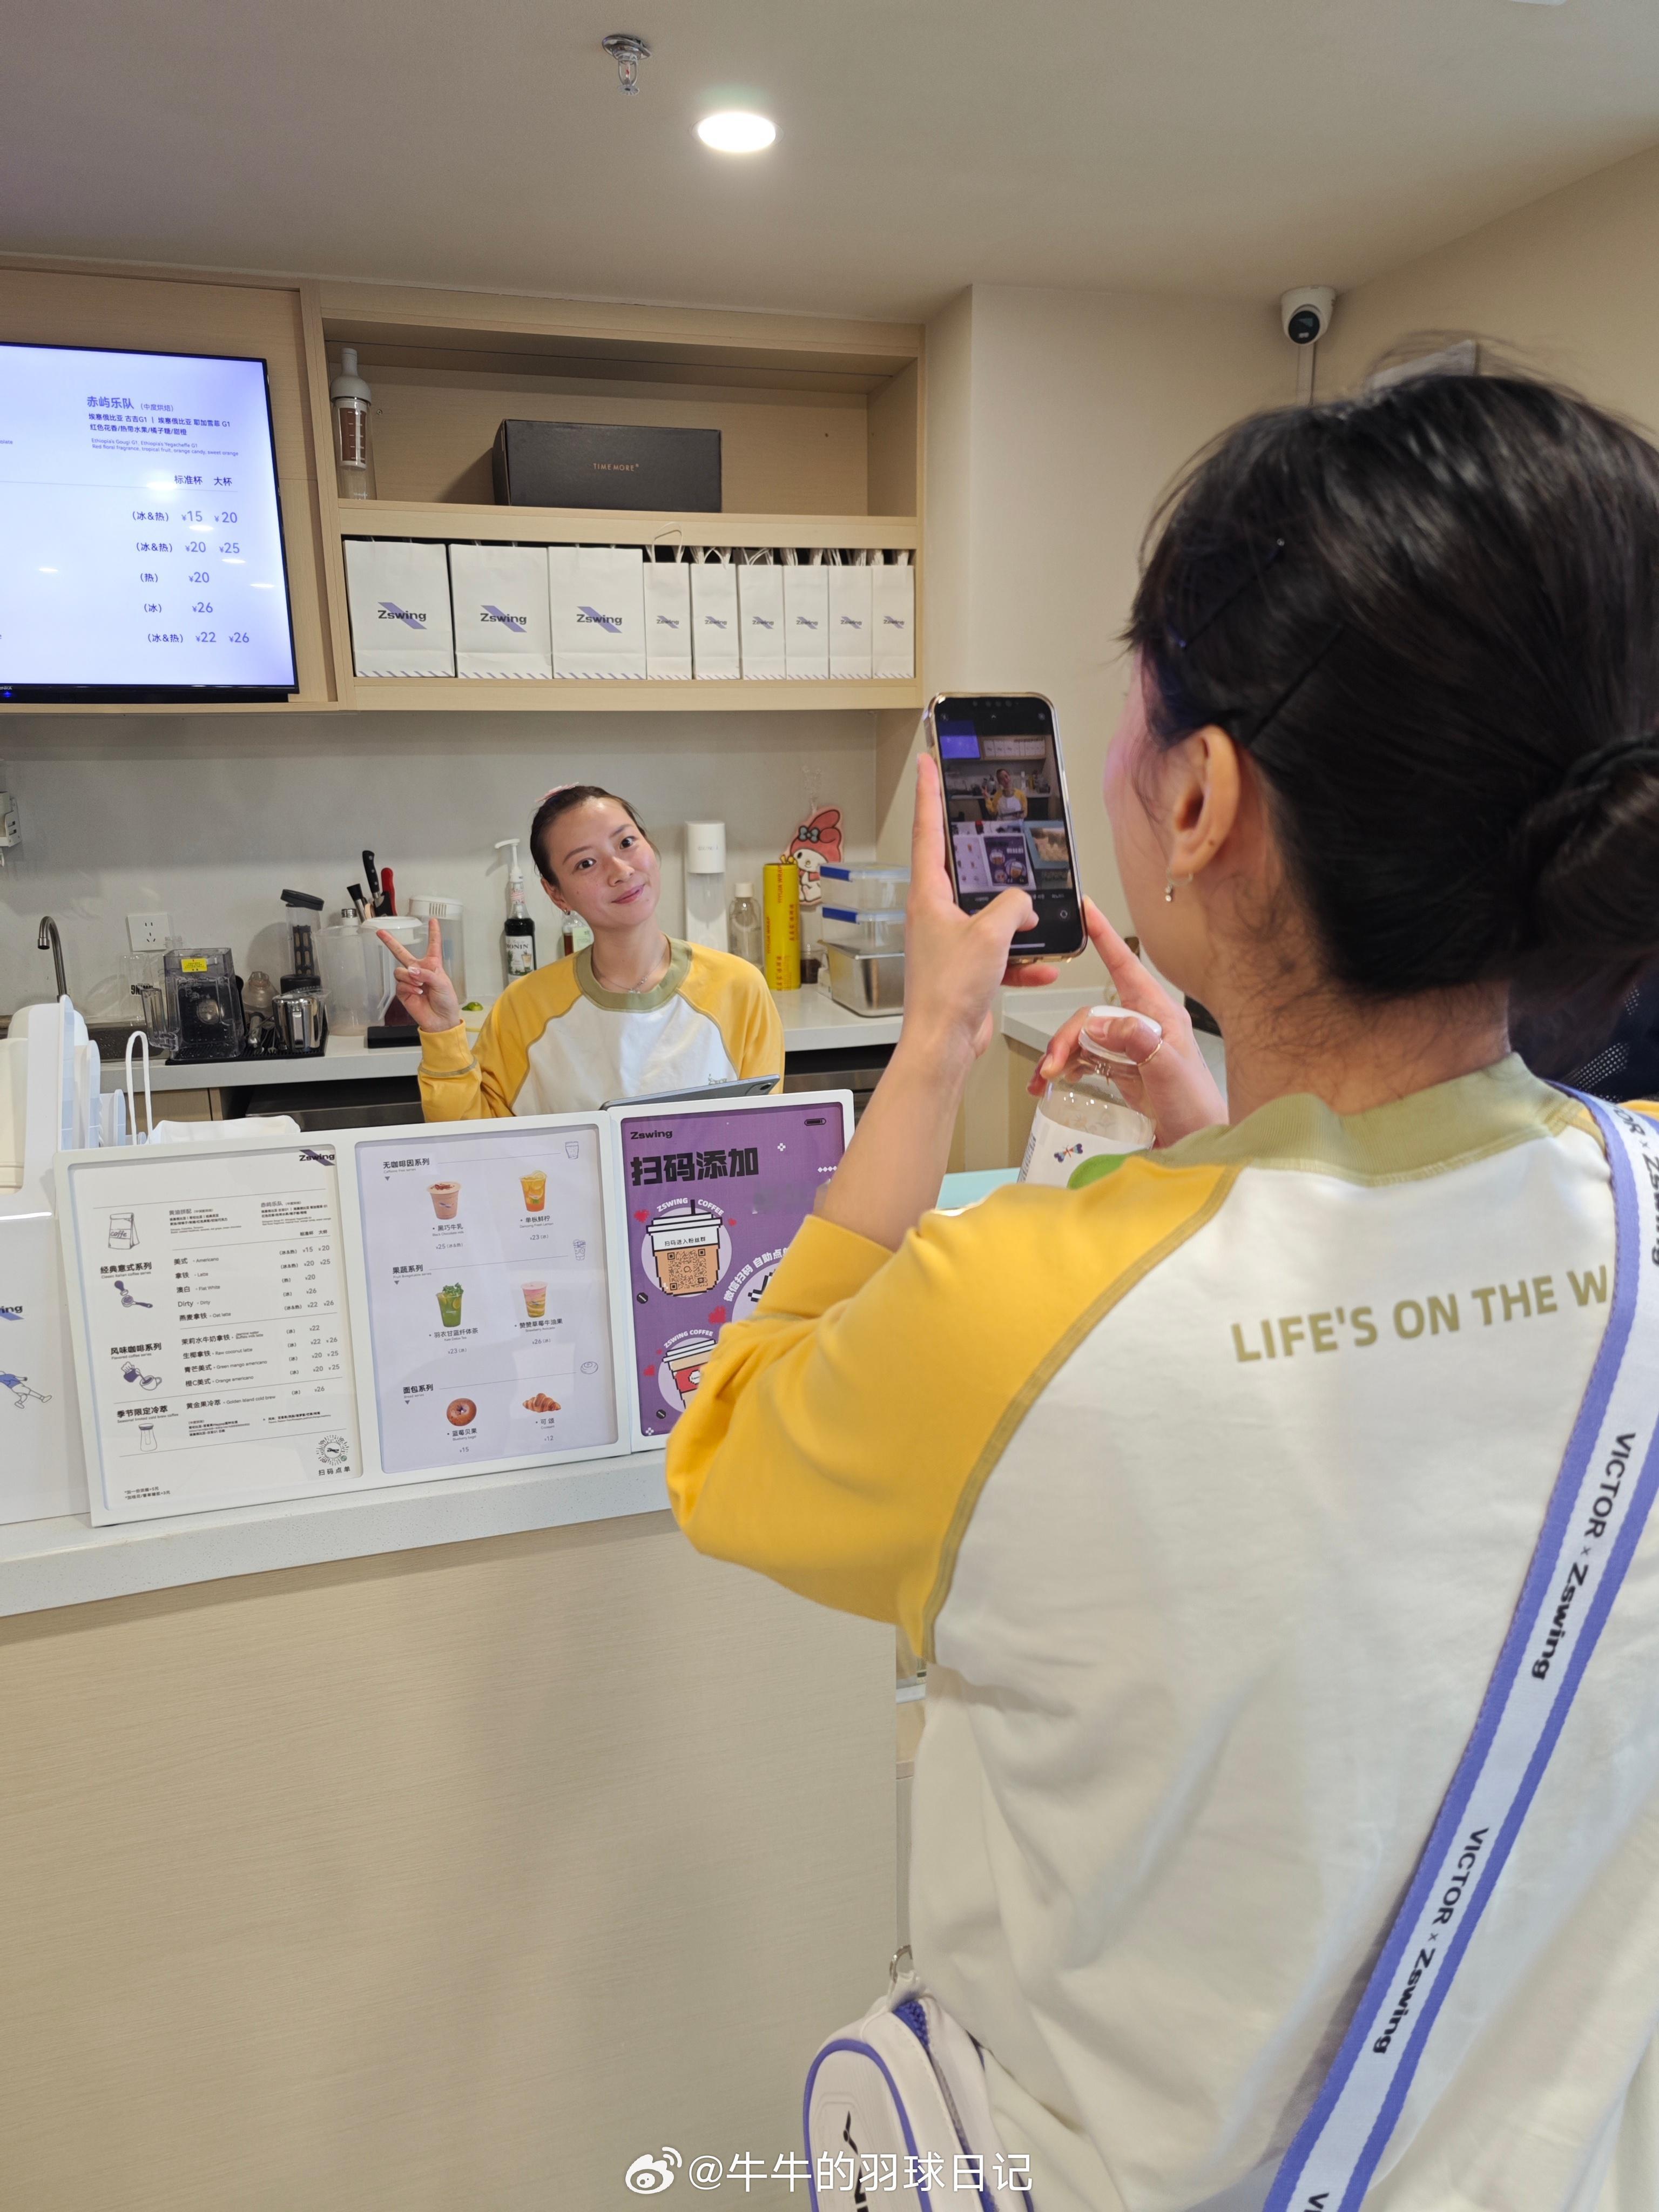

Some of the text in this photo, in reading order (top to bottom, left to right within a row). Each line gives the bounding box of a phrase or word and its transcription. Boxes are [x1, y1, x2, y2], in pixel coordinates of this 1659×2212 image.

[87, 396, 134, 409] 赤屿乐队
[174, 475, 233, 486] 标准杯 大杯
[132, 511, 168, 522] (冰&热)
[181, 511, 203, 522] ¥15
[136, 541, 240, 554] (冰&热) ¥20 ¥25
[140, 571, 210, 583] (热) ¥20
[144, 602, 213, 613] (冰) ¥26
[377, 610, 427, 622] Zswing
[480, 612, 527, 625] Zswing
[576, 613, 622, 626] Zswing
[147, 631, 249, 643] (冰&热) ¥22 ¥26
[630, 1130, 673, 1140] Zswing
[383, 1158, 430, 1169] 无咖啡因系列
[630, 1147, 759, 1186] 扫码添加
[657, 1197, 724, 1216] ZSWING COFFEE
[437, 1223, 463, 1231] 黑巧牛乳
[665, 1237, 706, 1246] 扫码进入粉丝群
[100, 1262, 152, 1274] 经典意式系列
[393, 1264, 423, 1274] 果蔬系列
[724, 1264, 753, 1301] 微信扫码
[179, 1312, 207, 1321] 燕麦拿铁
[1231, 1306, 1377, 1363] LIFE'S
[1393, 1293, 1460, 1340] ON
[1471, 1276, 1558, 1326] THE
[434, 1327, 478, 1338] 羽衣甘蓝纤体茶
[181, 1334, 231, 1345] 茉莉水牛奶拿铁
[664, 1331, 689, 1348] ZSWING
[111, 1343, 161, 1355] 风味咖啡系列
[183, 1350, 211, 1359] 生椰拿铁
[184, 1364, 212, 1373] 青芒美式
[185, 1378, 211, 1387] 橙C美式
[403, 1384, 433, 1394] 面包系列
[186, 1399, 221, 1410] 黄金果冷萃
[117, 1405, 168, 1418] 季节限定冷萃
[452, 1428, 477, 1437] 蓝莓贝果
[318, 1466, 350, 1476] 扫码点单
[1531, 1433, 1636, 1681] VICTOR Zswing
[1372, 1827, 1490, 2054] VICTOR Zswing
